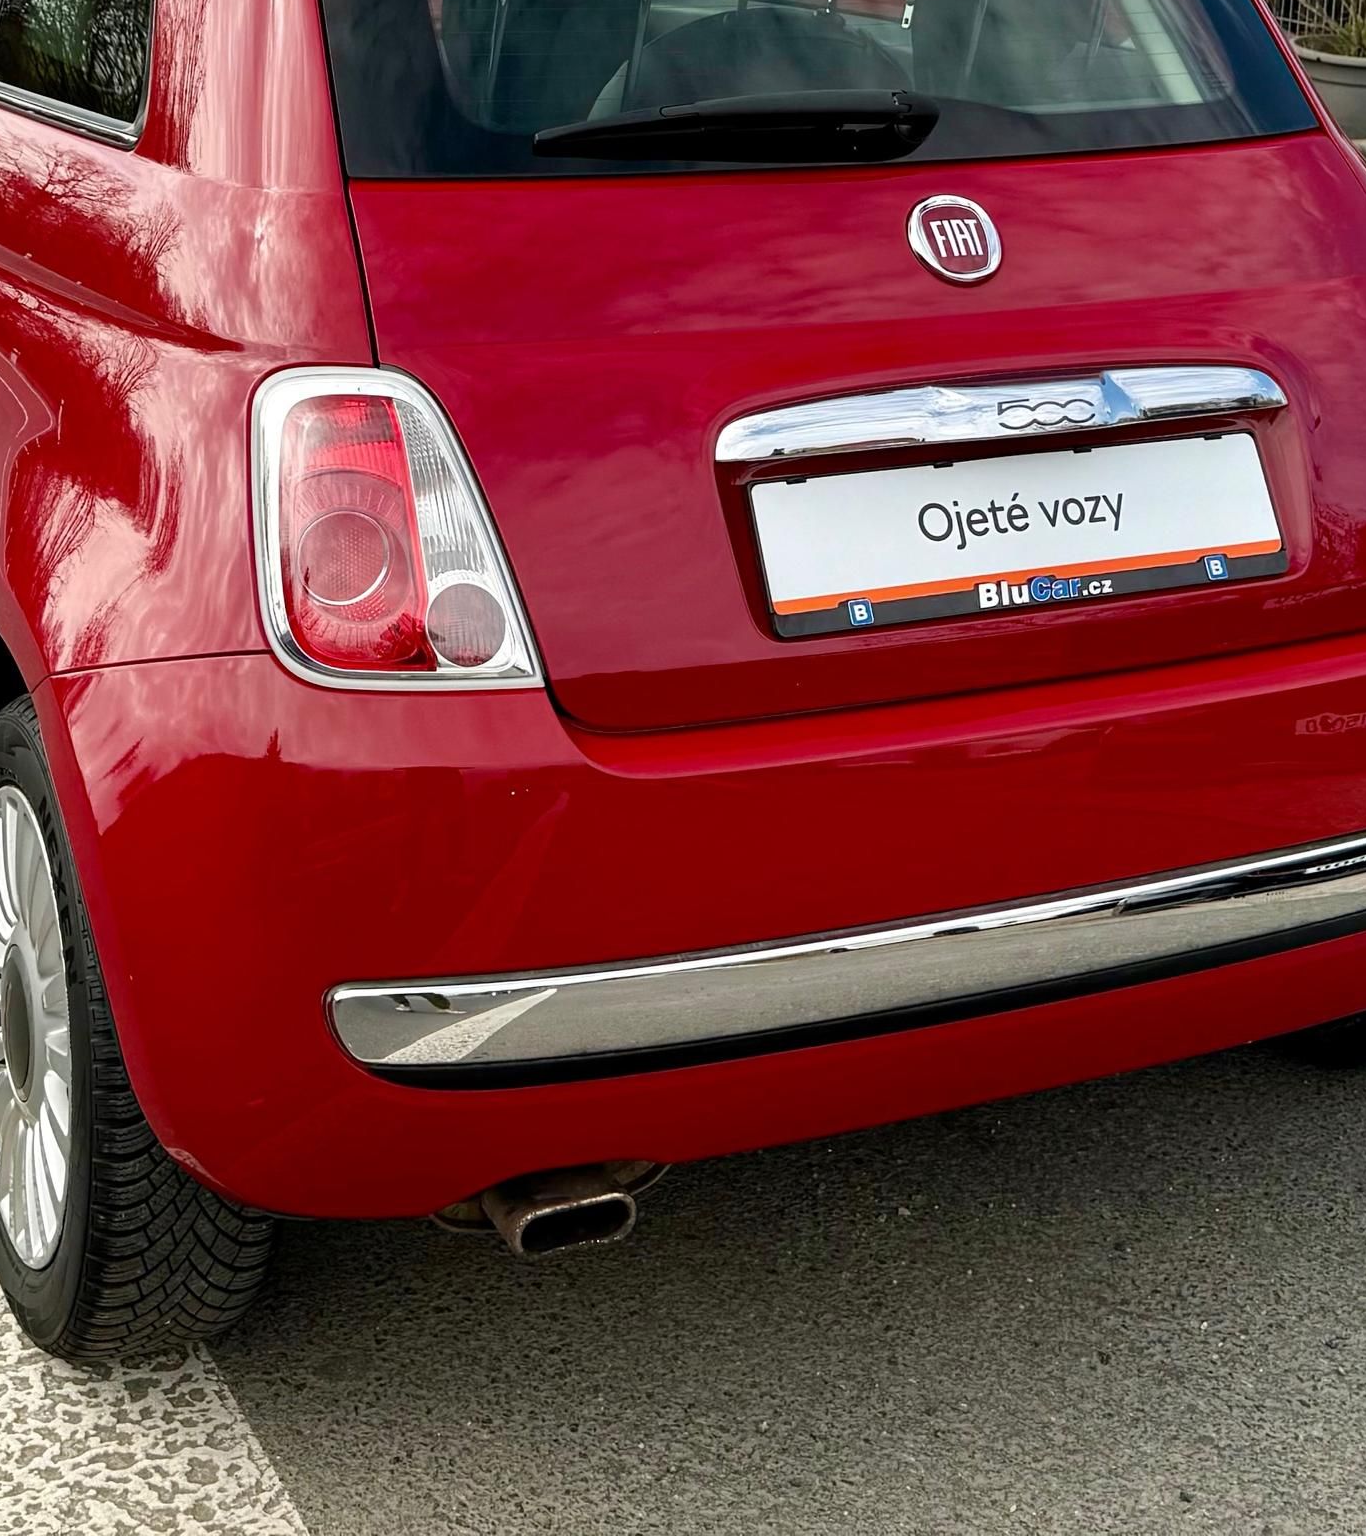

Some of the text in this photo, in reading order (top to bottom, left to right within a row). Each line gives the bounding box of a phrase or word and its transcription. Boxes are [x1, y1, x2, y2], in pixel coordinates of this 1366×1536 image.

[929, 219, 984, 258] FIAT
[997, 398, 1096, 430] 500
[918, 492, 1124, 550] Ojeté vozy
[1209, 559, 1224, 576] B
[978, 575, 1114, 609] BluCar.cz
[853, 604, 868, 621] B
[38, 796, 78, 988] NEXEN
